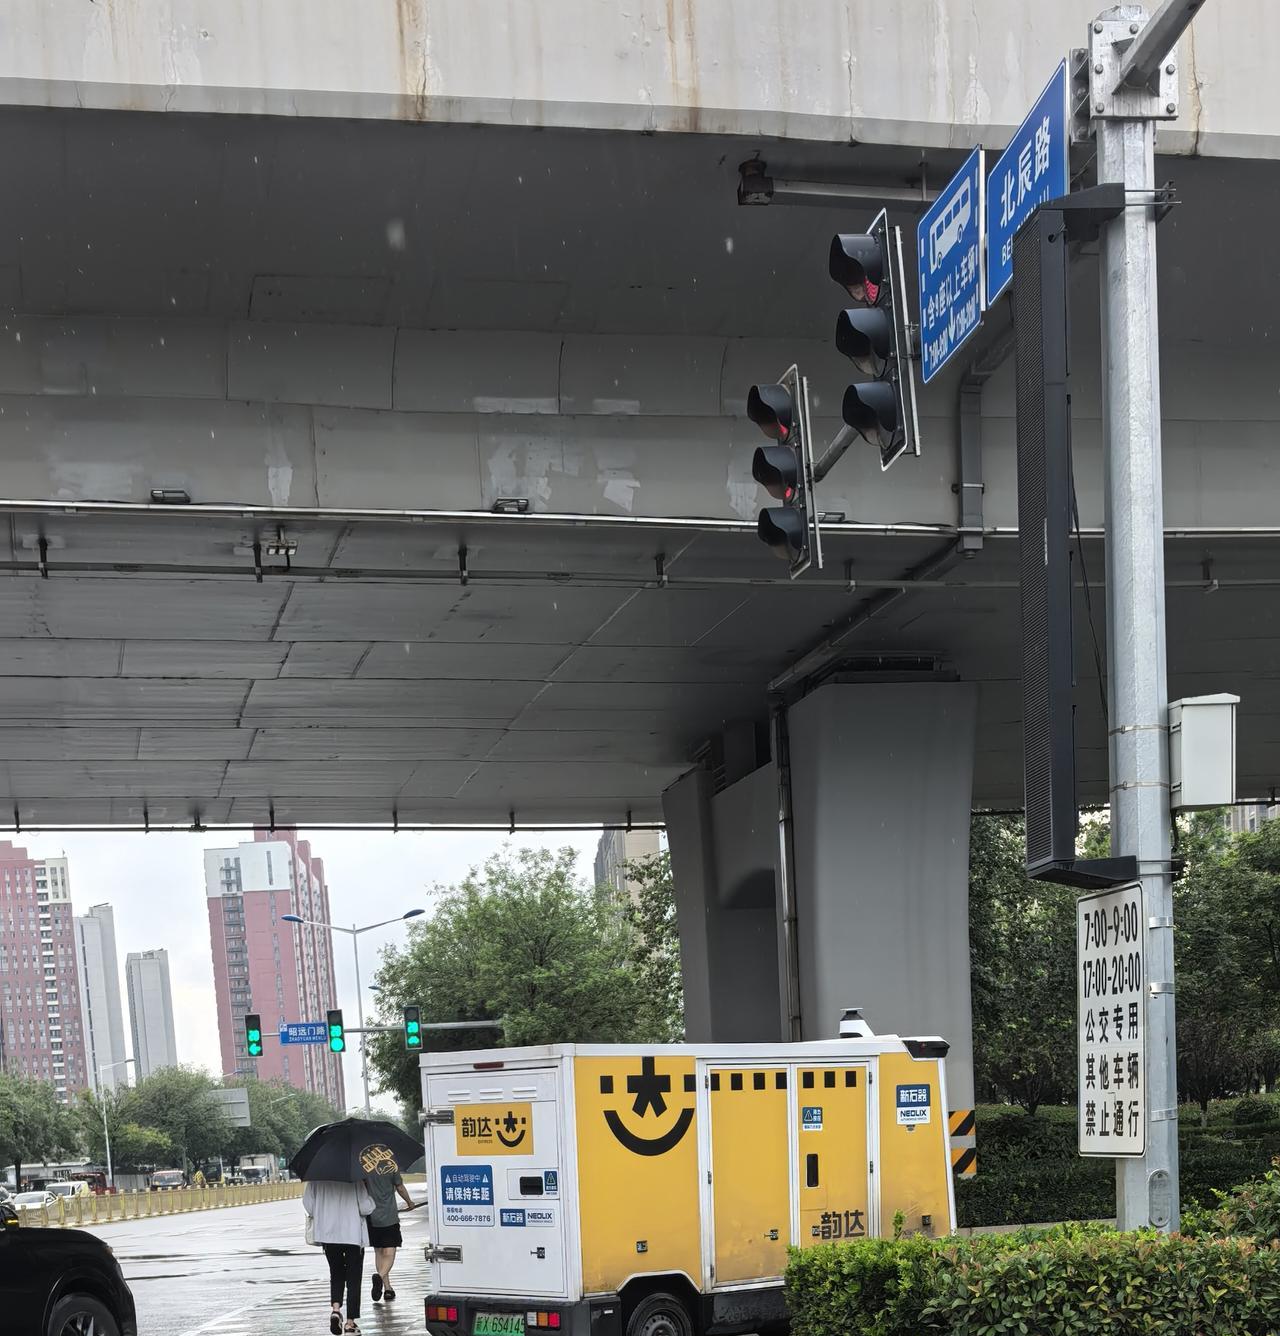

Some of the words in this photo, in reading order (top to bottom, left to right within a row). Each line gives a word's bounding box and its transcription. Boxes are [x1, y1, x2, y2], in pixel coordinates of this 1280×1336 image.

[1000, 115, 1051, 229] 北辰路
[1084, 901, 1138, 951] 7:00-9:00
[1083, 951, 1141, 998] 17:00-20:00
[288, 1026, 325, 1036] 昭远门路
[1085, 1002, 1138, 1044] 公交专用
[1085, 1052, 1139, 1091] 其他车辆
[900, 1088, 927, 1102] 新石器
[900, 1109, 927, 1117] NEOLIX
[1085, 1100, 1139, 1138] 禁止通行
[461, 1116, 493, 1138] 韵达
[452, 1173, 481, 1183] 自动驾驶中
[445, 1187, 490, 1201] 请保持车距
[502, 1212, 524, 1223] 新石器
[821, 1209, 865, 1240] 韵达
